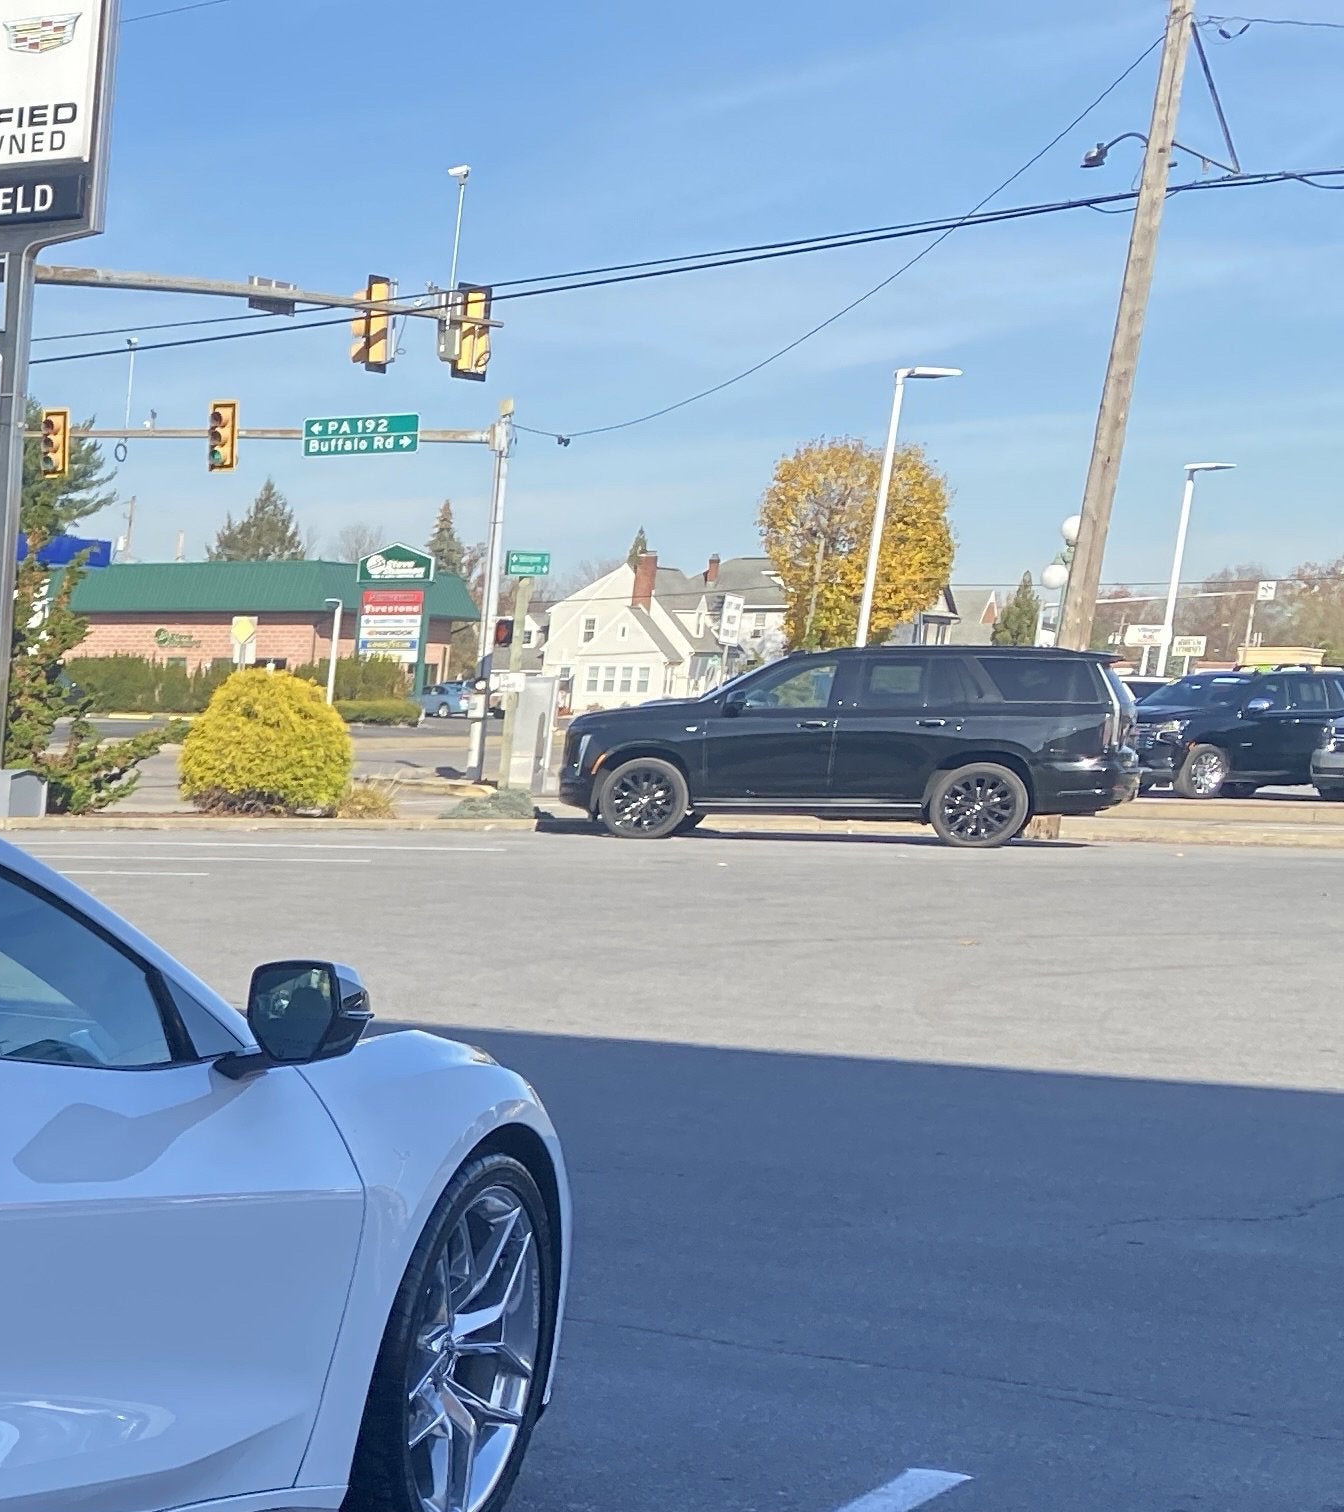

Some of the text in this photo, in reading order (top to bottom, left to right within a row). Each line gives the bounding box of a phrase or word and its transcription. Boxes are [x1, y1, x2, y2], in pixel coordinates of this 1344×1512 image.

[328, 419, 389, 434] PA 192
[309, 436, 394, 452] Buffalo Rd
